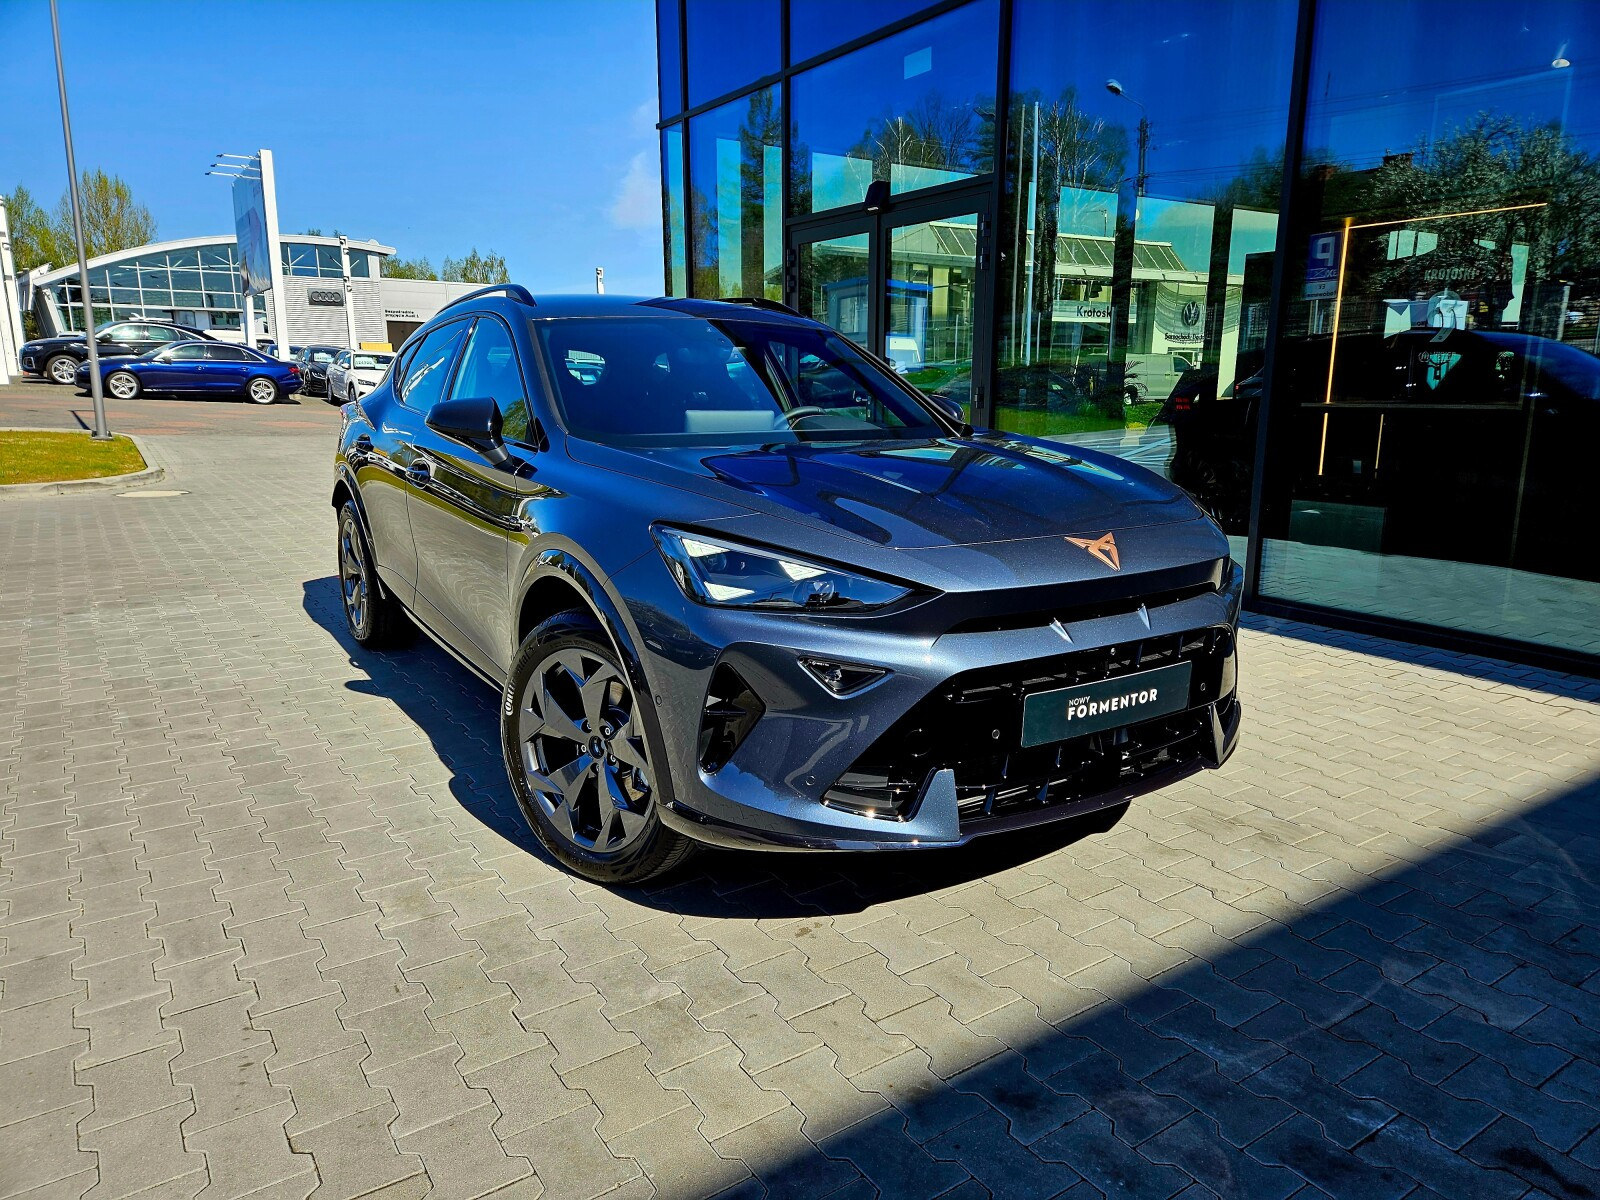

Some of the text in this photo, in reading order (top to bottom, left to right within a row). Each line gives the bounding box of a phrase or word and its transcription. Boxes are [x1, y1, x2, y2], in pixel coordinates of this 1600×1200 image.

[1076, 306, 1112, 318] Krotosk
[1067, 688, 1158, 721] FORMENTOR
[1068, 695, 1091, 707] NOWY
